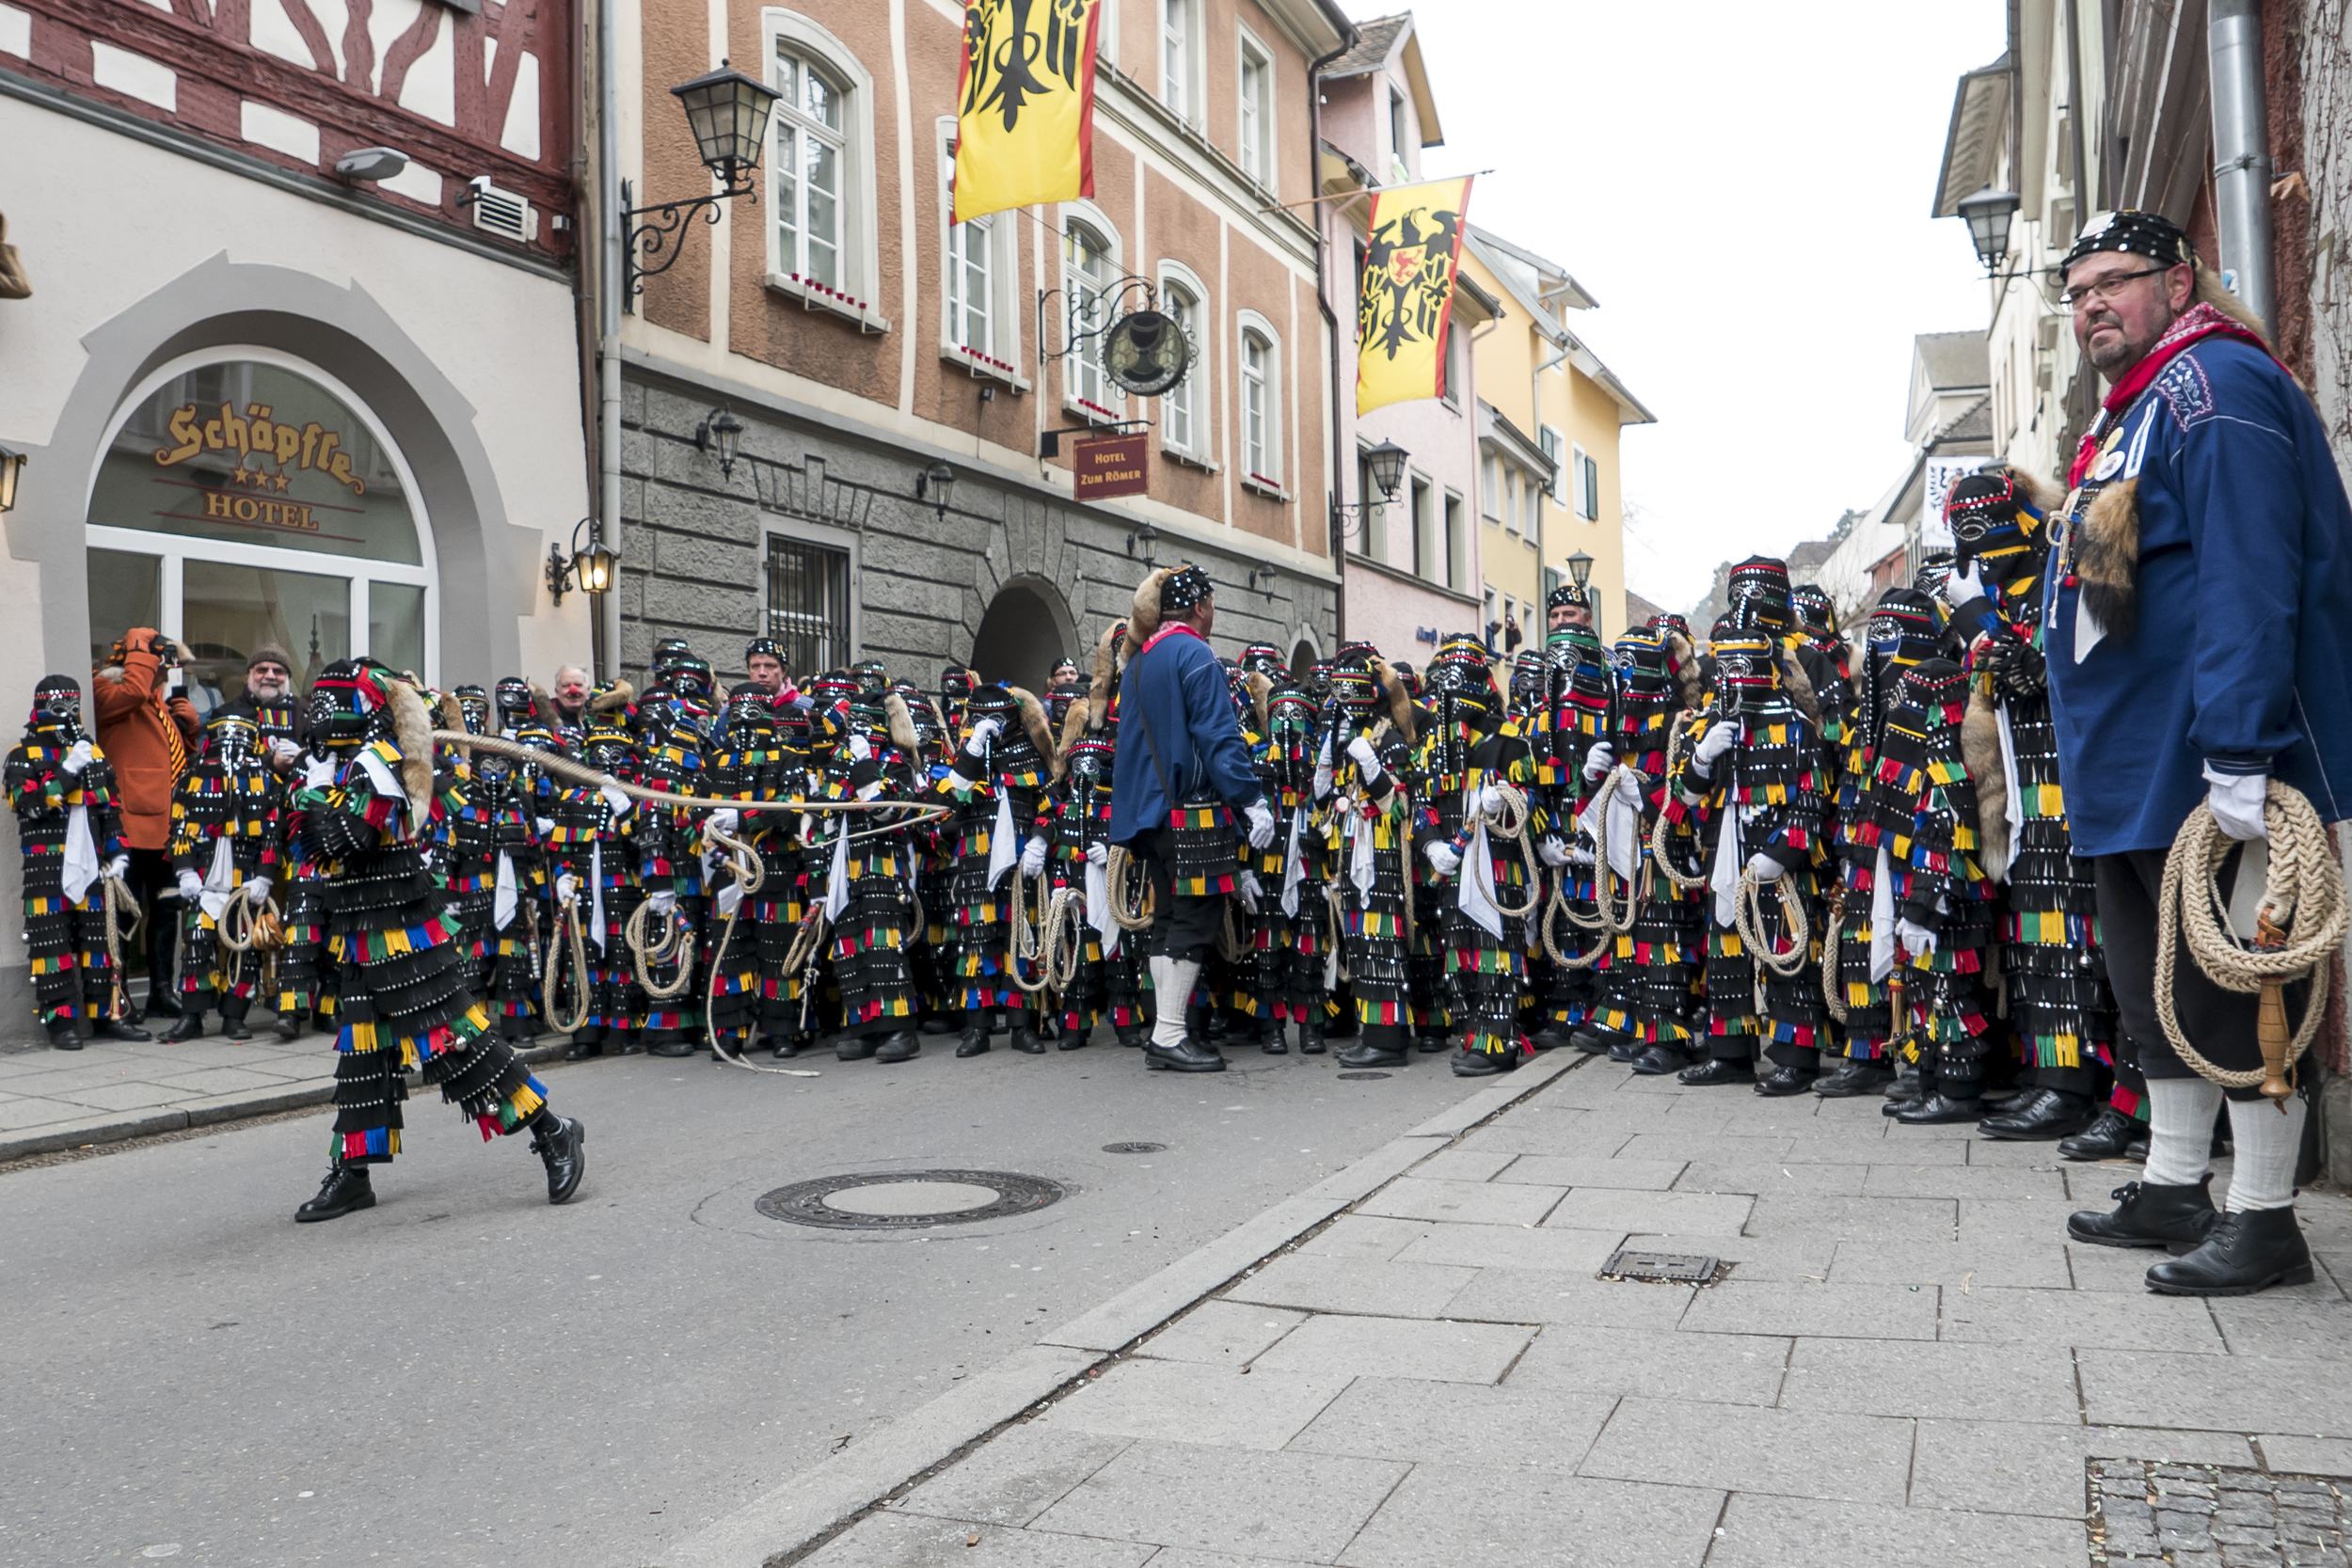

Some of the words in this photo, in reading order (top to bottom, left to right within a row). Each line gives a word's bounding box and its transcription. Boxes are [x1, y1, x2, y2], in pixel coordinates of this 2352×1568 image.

[154, 400, 365, 496] Schäpfle
[1094, 452, 1126, 465] HOTEL
[1080, 473, 1104, 485] ZUM
[1104, 469, 1141, 483] RÖMER
[205, 492, 320, 531] HOTEL
